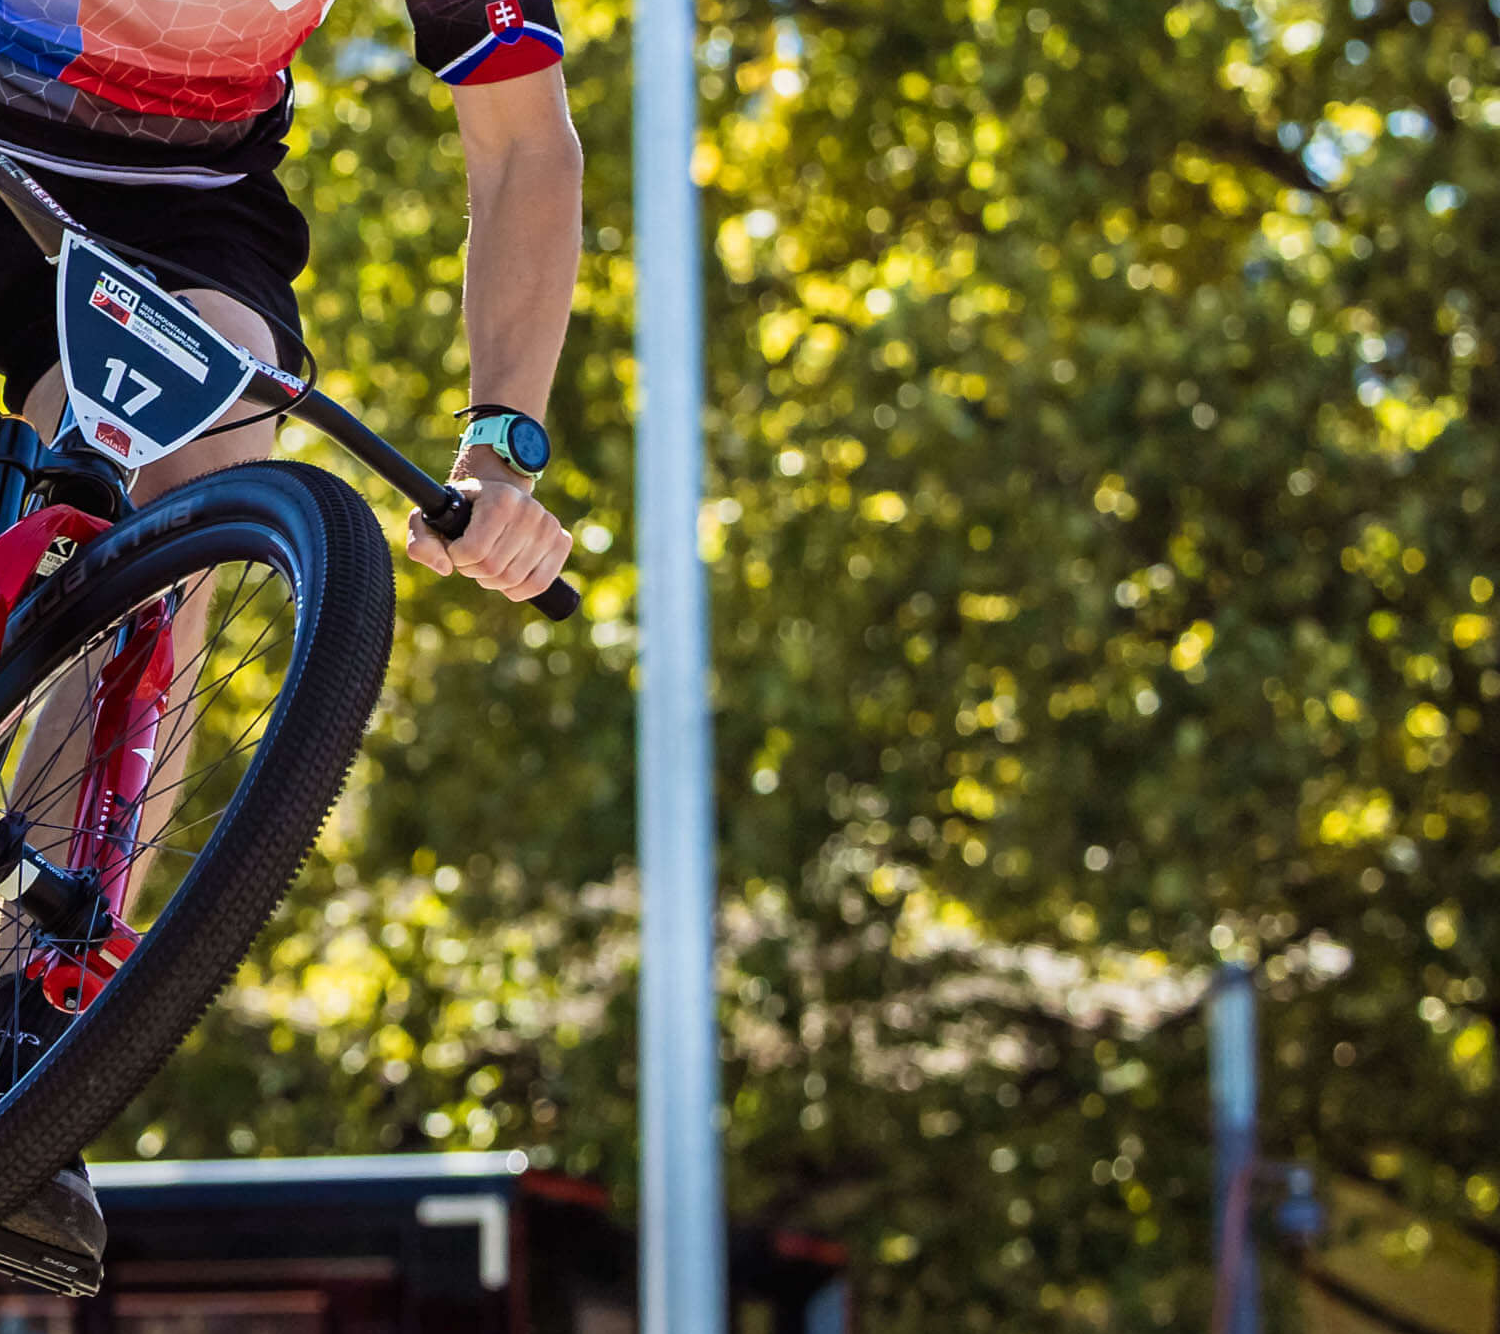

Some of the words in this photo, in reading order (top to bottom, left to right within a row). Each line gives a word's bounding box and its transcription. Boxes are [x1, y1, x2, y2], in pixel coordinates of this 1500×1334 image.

[105, 279, 137, 308] UCI
[138, 308, 161, 327] WORLD
[160, 323, 209, 363] CHAMPIONSHIPS
[155, 311, 188, 337] MOUNTAIN
[102, 357, 163, 417] 17
[97, 431, 127, 456] Valais
